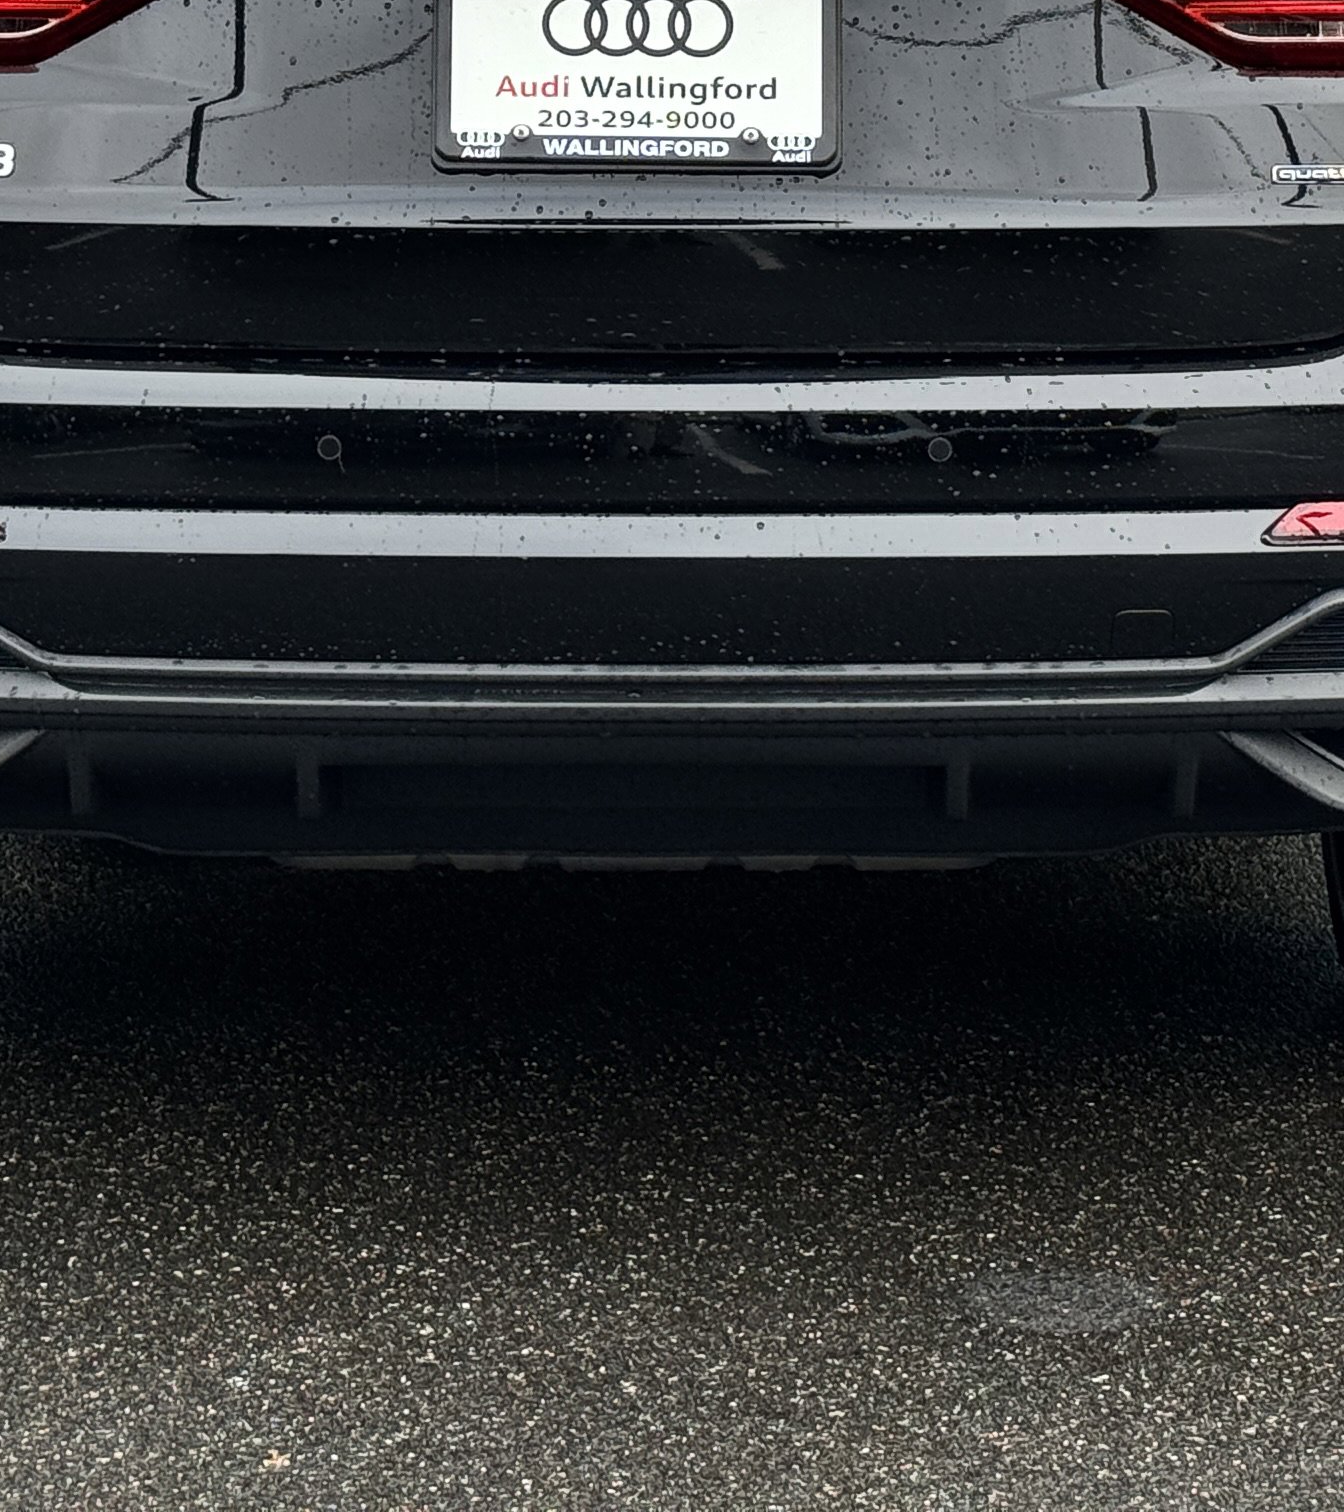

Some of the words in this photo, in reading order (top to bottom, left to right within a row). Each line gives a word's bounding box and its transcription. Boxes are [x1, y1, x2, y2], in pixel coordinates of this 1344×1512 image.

[495, 75, 570, 98] Audi
[580, 76, 777, 105] Wallingford
[537, 109, 736, 129] 203-294-9000
[460, 146, 501, 159] Audi
[543, 138, 730, 157] WALLINGFORD
[771, 150, 812, 163] Audi
